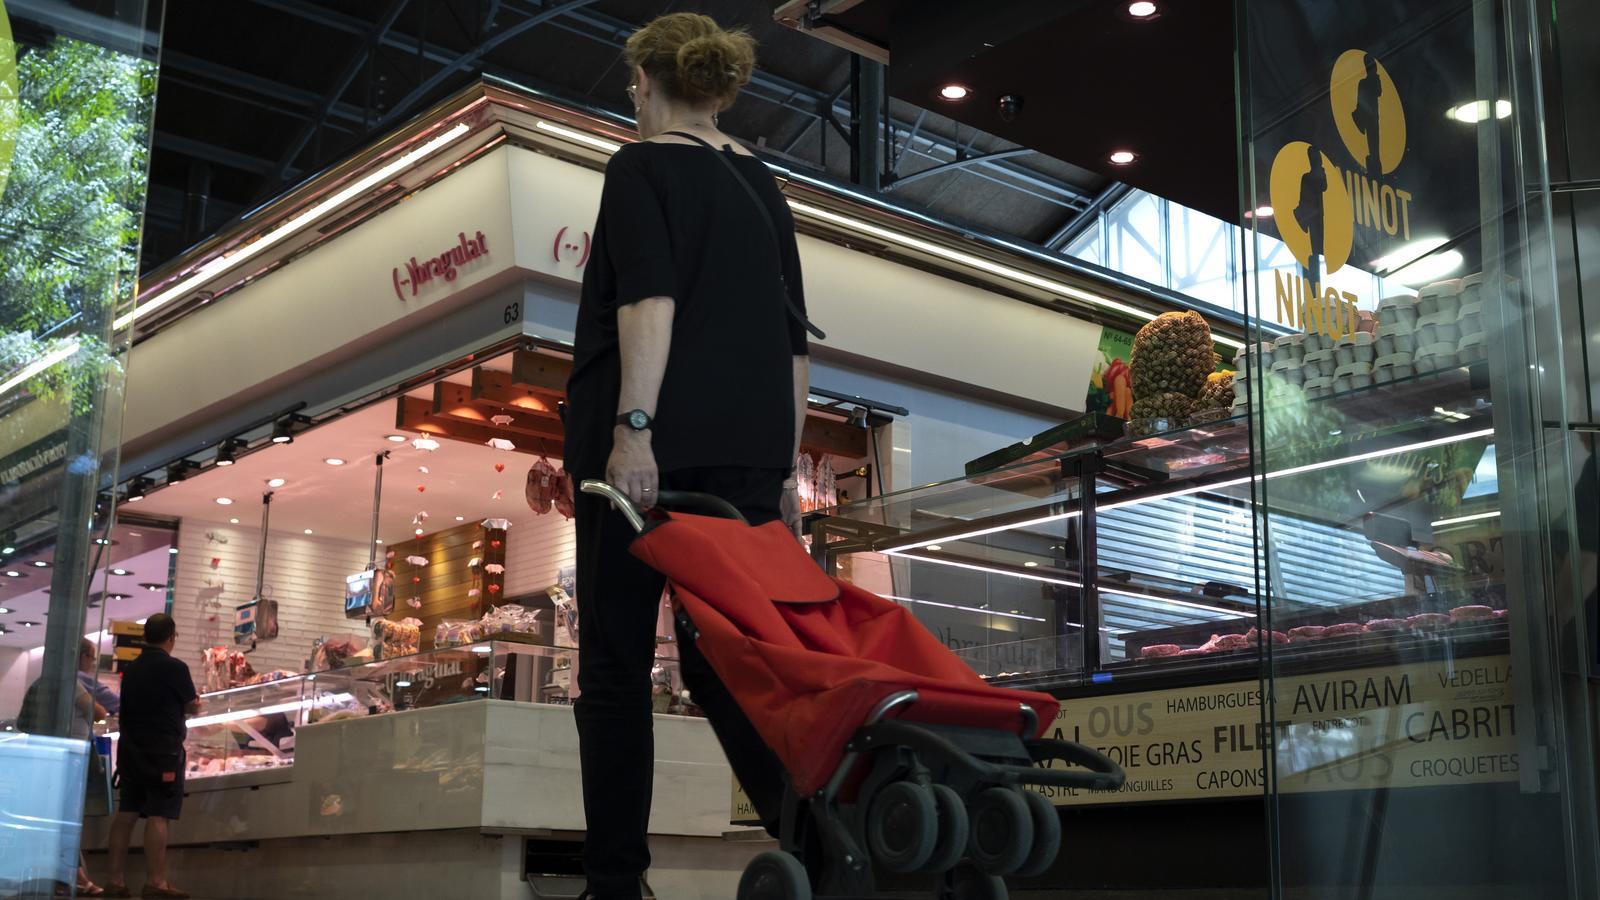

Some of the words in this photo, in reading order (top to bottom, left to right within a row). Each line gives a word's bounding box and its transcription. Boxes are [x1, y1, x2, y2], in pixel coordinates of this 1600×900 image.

[1337, 166, 1412, 241] NINOT
[504, 302, 519, 325] 63
[1274, 268, 1358, 343] NINOT
[1167, 688, 1277, 714] HAMBURGUESA
[1293, 674, 1412, 715] AVIRAM
[1088, 702, 1154, 738] OUS
[1214, 720, 1292, 753] FILET
[1405, 703, 1516, 744] CABRIT
[1146, 740, 1203, 767] GRAS
[1410, 753, 1519, 778] CROQUETES
[1196, 767, 1266, 790] CAPONS
